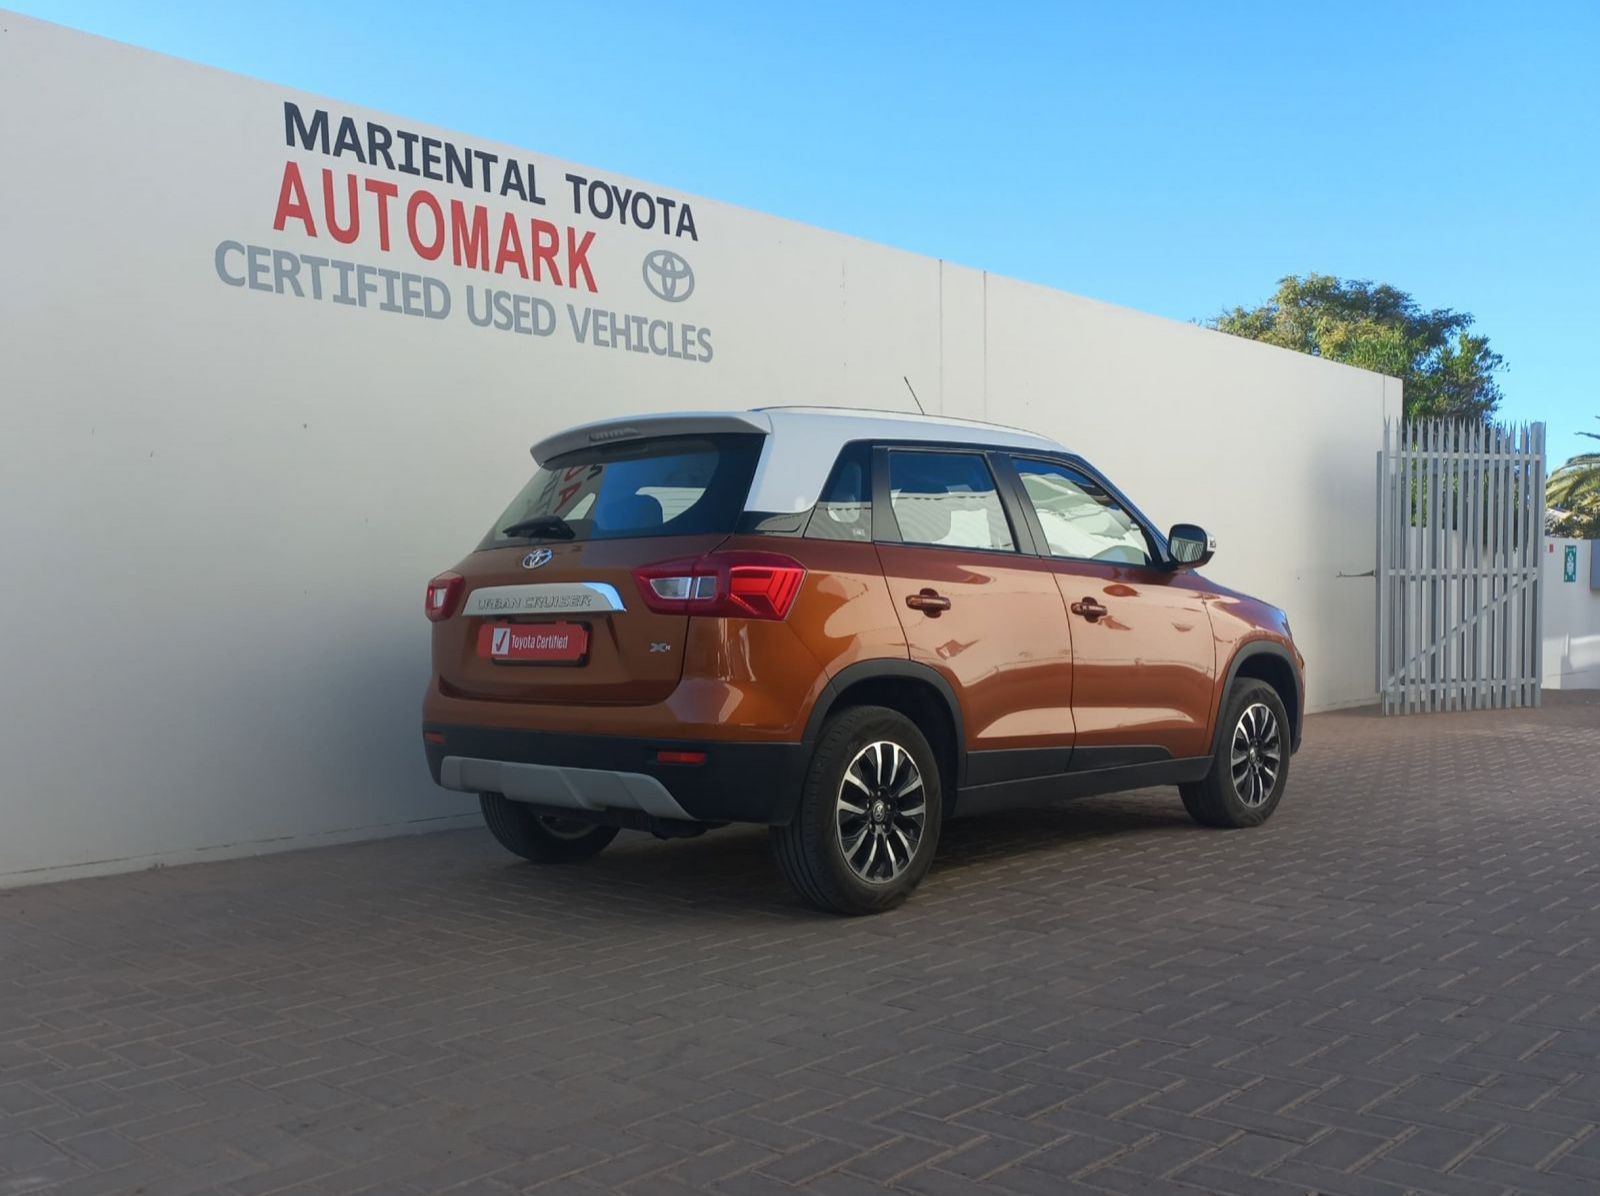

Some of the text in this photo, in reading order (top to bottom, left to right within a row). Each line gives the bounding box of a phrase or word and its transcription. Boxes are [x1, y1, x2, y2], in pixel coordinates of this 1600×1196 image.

[273, 161, 599, 294] AUTOMARK
[283, 101, 699, 242] MARIENTAL TOYOTA
[214, 240, 713, 363] CERTIFIED USED VEHICLES
[477, 595, 592, 610] URBAN CRUISER
[511, 635, 568, 650] Toyota Certified
